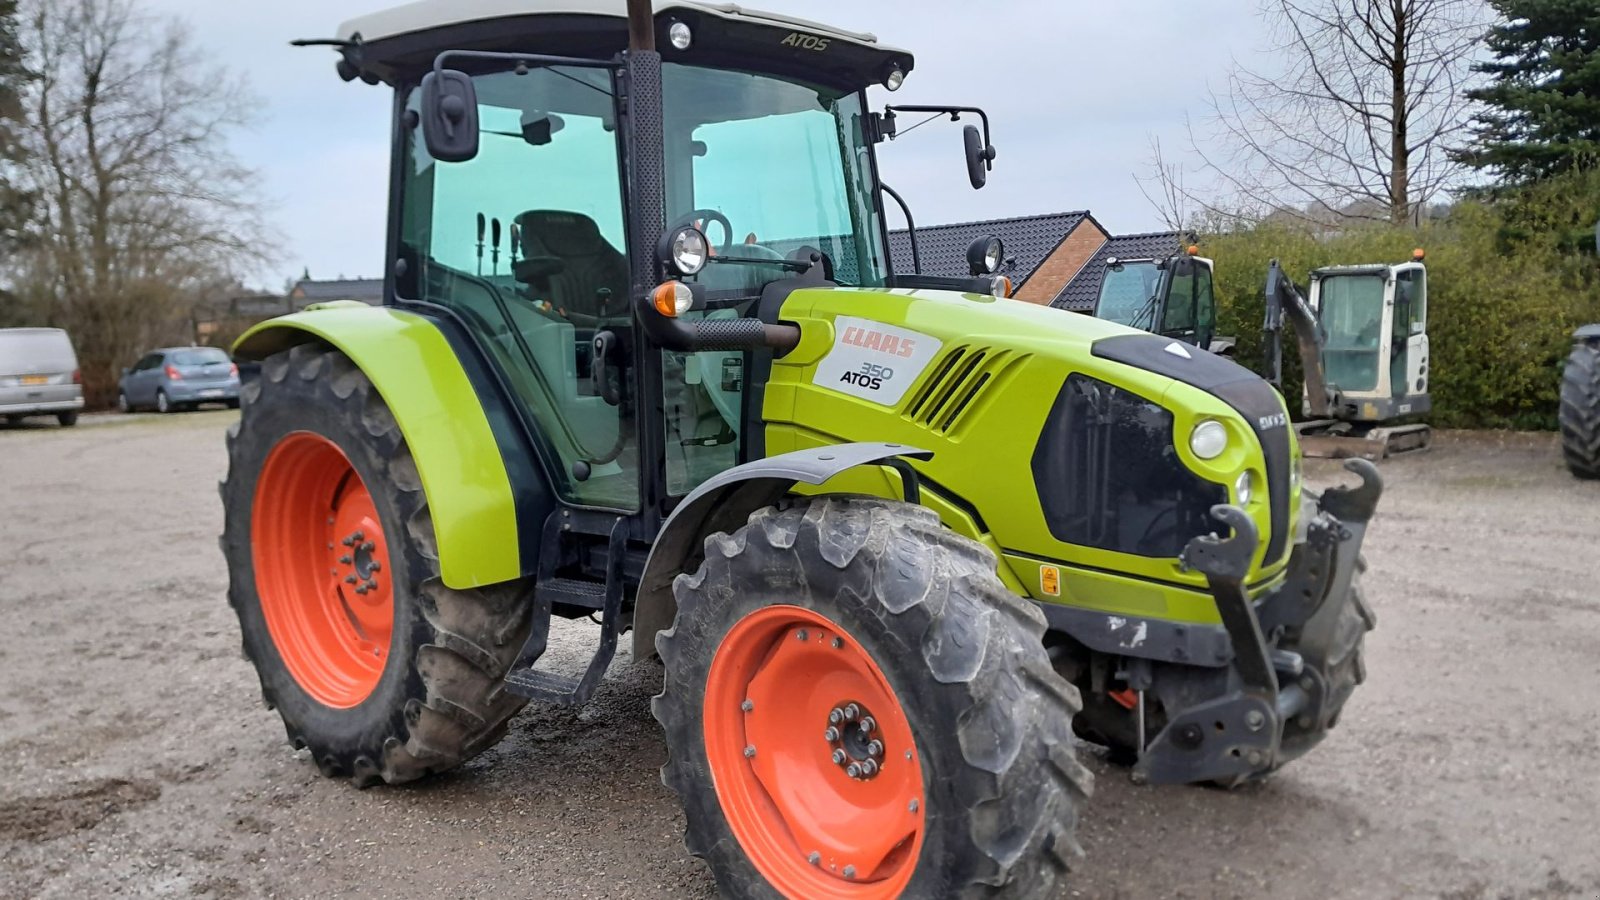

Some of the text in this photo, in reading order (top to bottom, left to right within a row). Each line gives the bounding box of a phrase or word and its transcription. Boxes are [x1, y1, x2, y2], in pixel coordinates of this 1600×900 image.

[781, 32, 831, 51] ATOS
[841, 326, 916, 358] CLAAS
[840, 371, 882, 390] ATOS
[860, 362, 894, 380] 350
